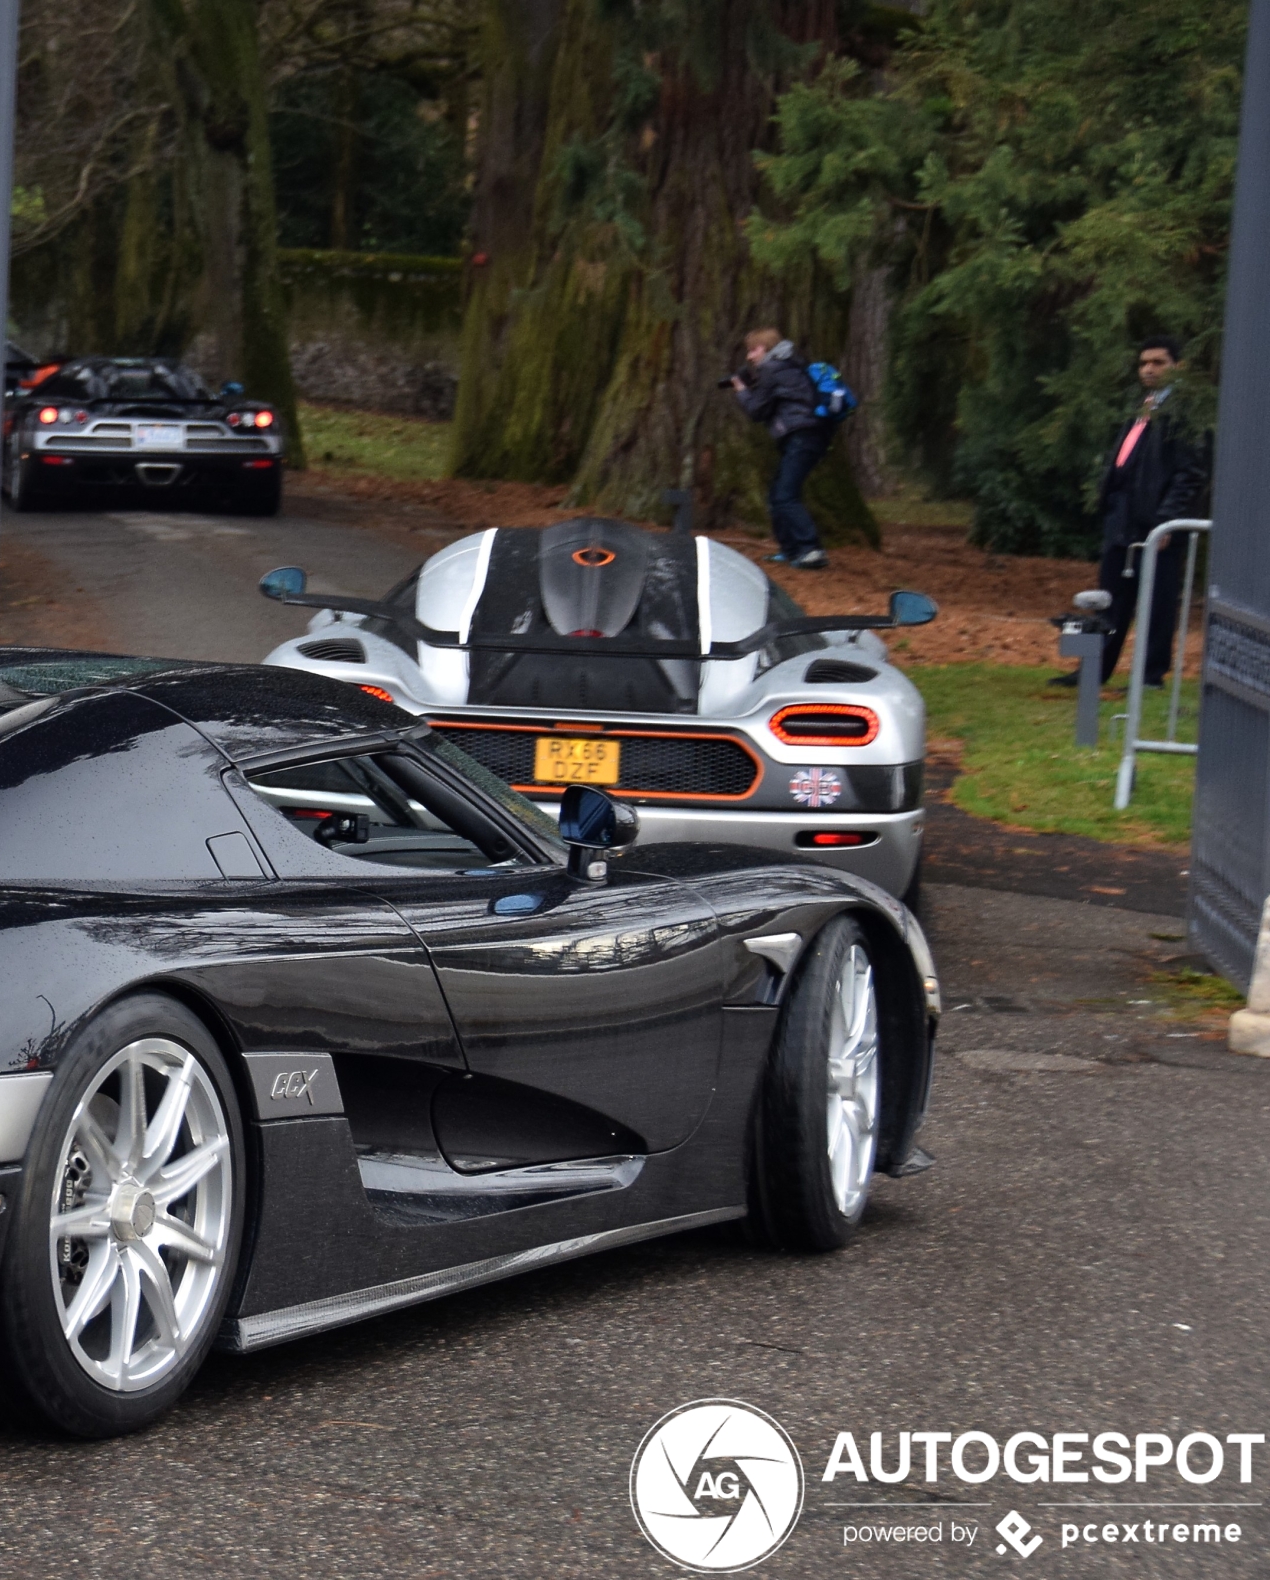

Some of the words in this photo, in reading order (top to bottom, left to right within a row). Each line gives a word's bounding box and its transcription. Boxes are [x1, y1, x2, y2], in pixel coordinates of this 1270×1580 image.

[550, 741, 606, 761] RX66
[553, 761, 599, 780] DZF
[271, 1069, 318, 1106] CCX
